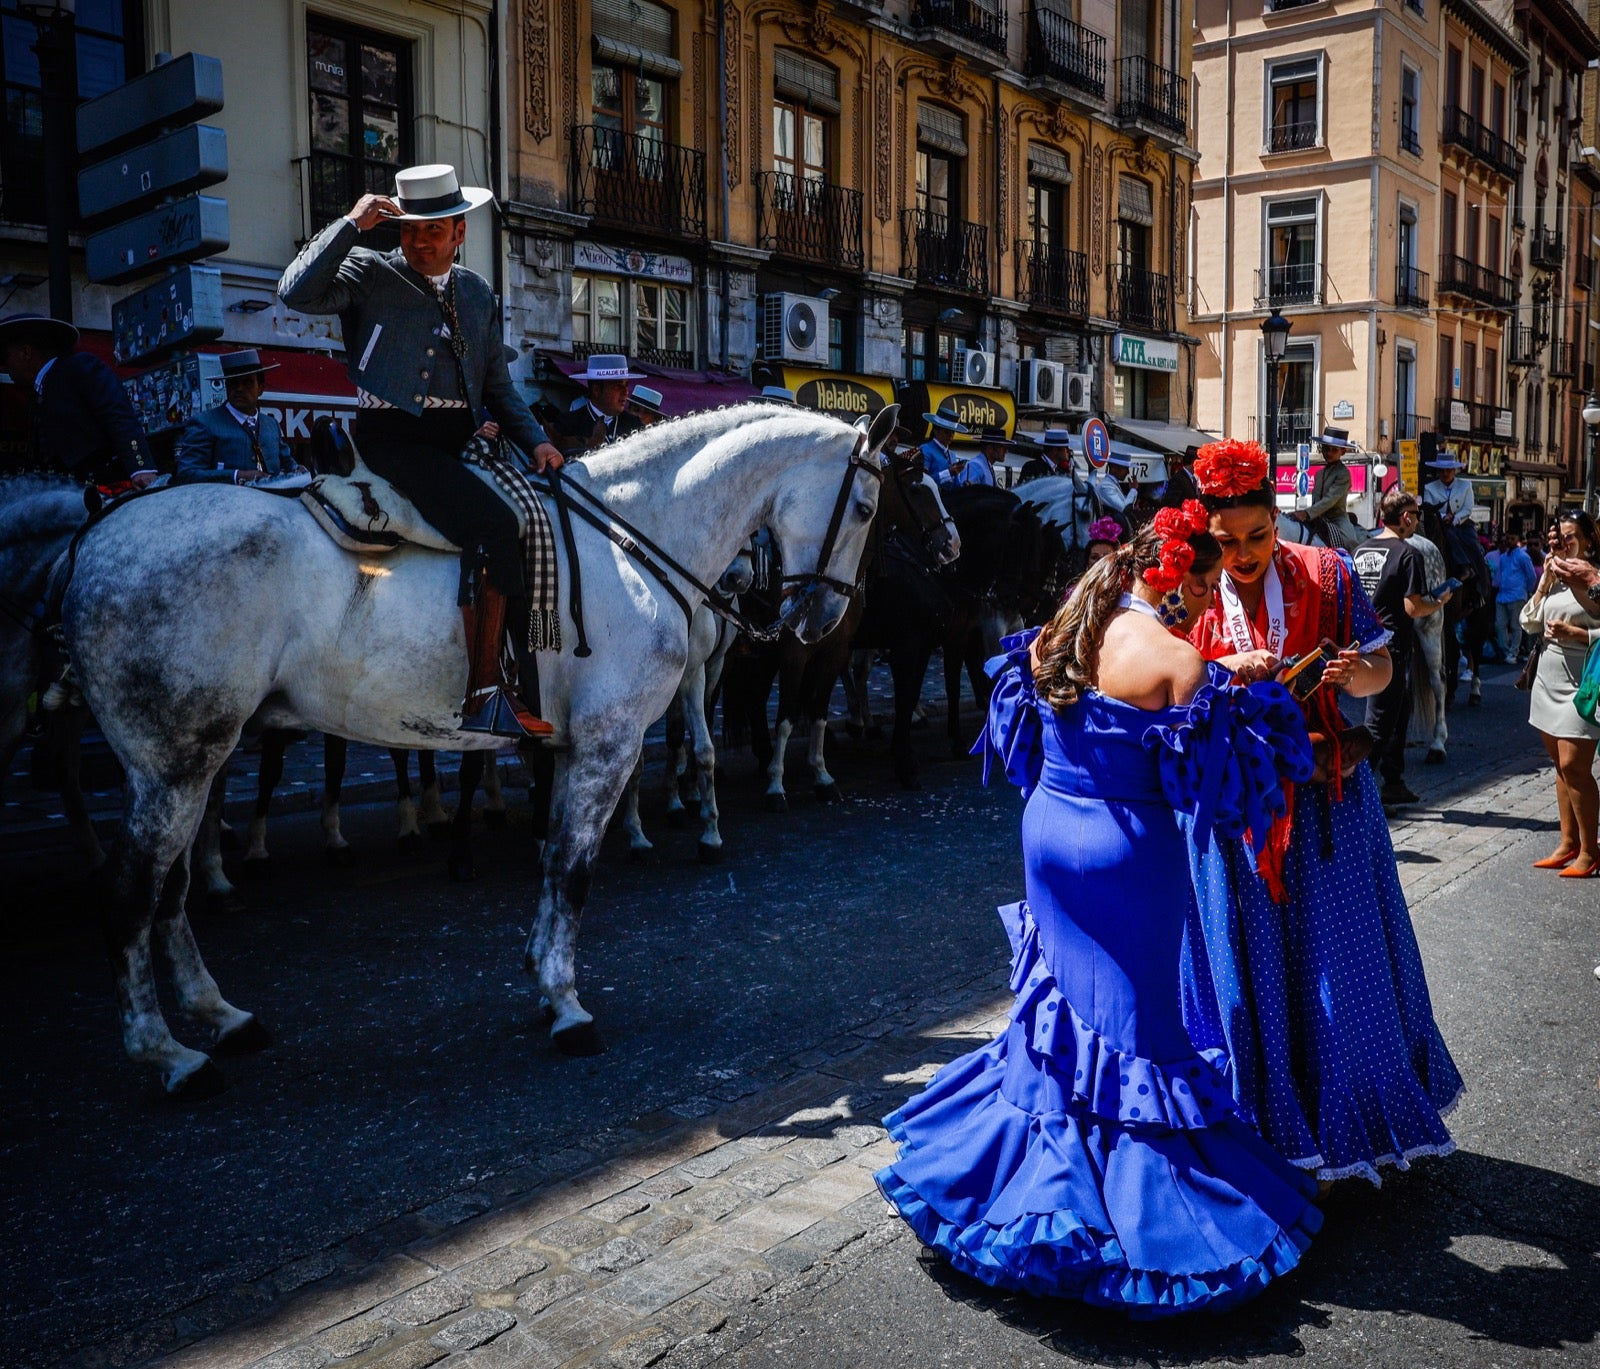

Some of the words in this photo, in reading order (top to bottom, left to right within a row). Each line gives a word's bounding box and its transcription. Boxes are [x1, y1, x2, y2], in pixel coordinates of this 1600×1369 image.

[1121, 337, 1147, 365] ATA
[815, 380, 868, 413] Helados
[967, 399, 996, 426] Perla
